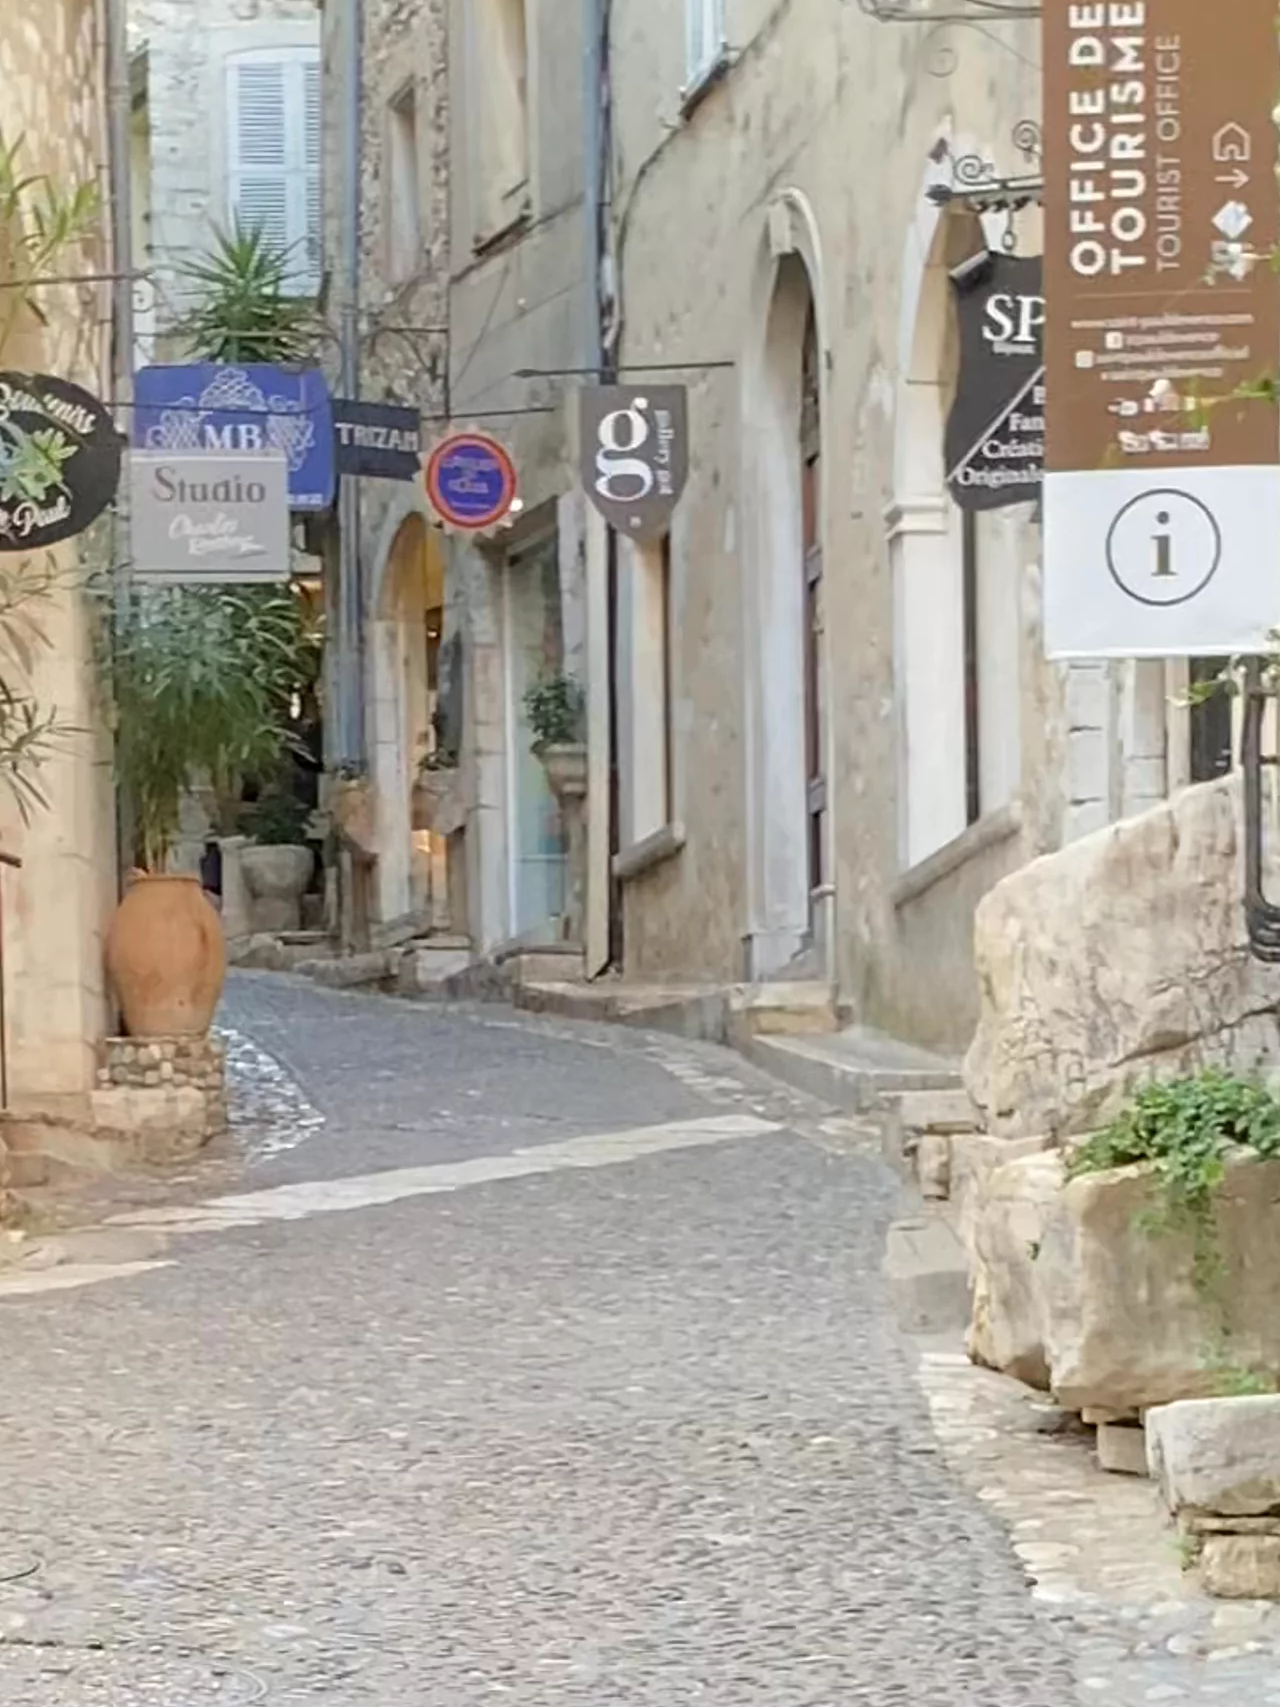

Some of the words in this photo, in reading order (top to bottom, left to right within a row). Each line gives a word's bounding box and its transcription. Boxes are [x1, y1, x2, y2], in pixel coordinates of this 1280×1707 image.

[1068, 1, 1106, 66] DE
[1108, 0, 1147, 276] TOURISME
[1154, 34, 1182, 142] OFFICE
[1068, 89, 1106, 276] OFFICE
[1154, 153, 1182, 273] TOURIST
[152, 465, 267, 504] Studio
[204, 423, 263, 450] MB
[595, 396, 654, 502] g
[12, 495, 72, 537] Paul
